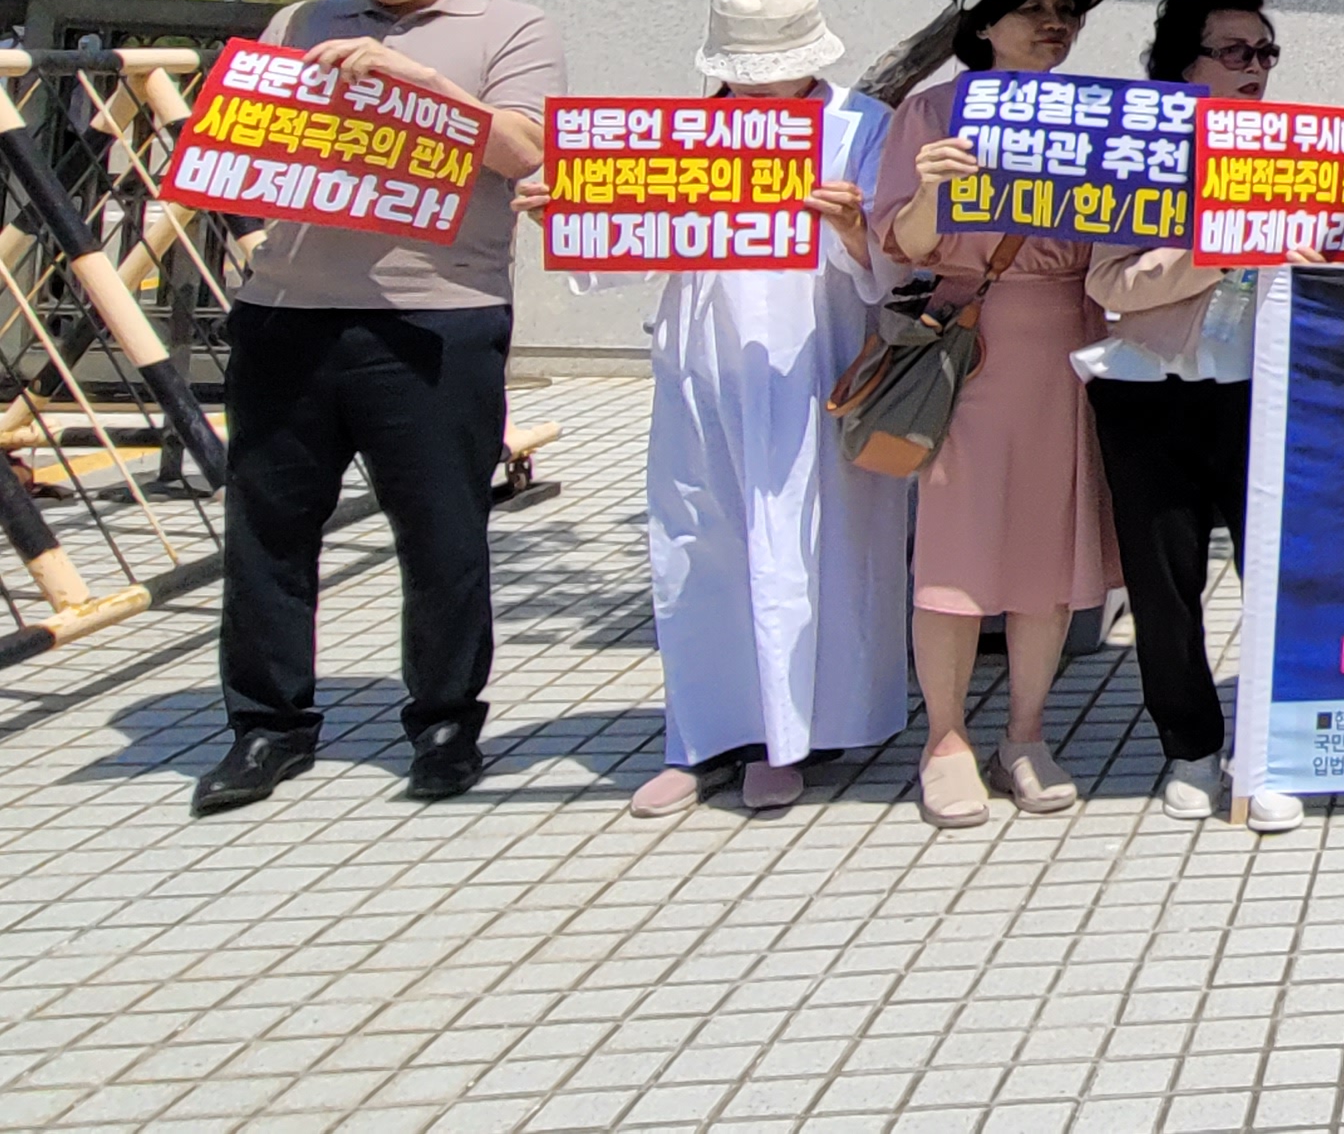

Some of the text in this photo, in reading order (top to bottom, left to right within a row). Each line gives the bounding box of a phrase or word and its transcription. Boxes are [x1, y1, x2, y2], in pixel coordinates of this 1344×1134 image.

[222, 49, 480, 146] 법문언 무시하는
[962, 78, 1197, 133] 동성결혼 옹호
[193, 95, 473, 187] 사법적극주의 판사
[556, 108, 813, 150] 법문언 무시하는
[958, 125, 1190, 183] 대법관 추천
[1207, 110, 1288, 150] 법문언
[174, 146, 460, 231] 배제하라!
[551, 157, 815, 203] 사법적극주의 판사
[950, 173, 1188, 238] 반/대/한/다!
[1202, 156, 1338, 203] 사법적극주의
[551, 210, 811, 258] 배제하라!
